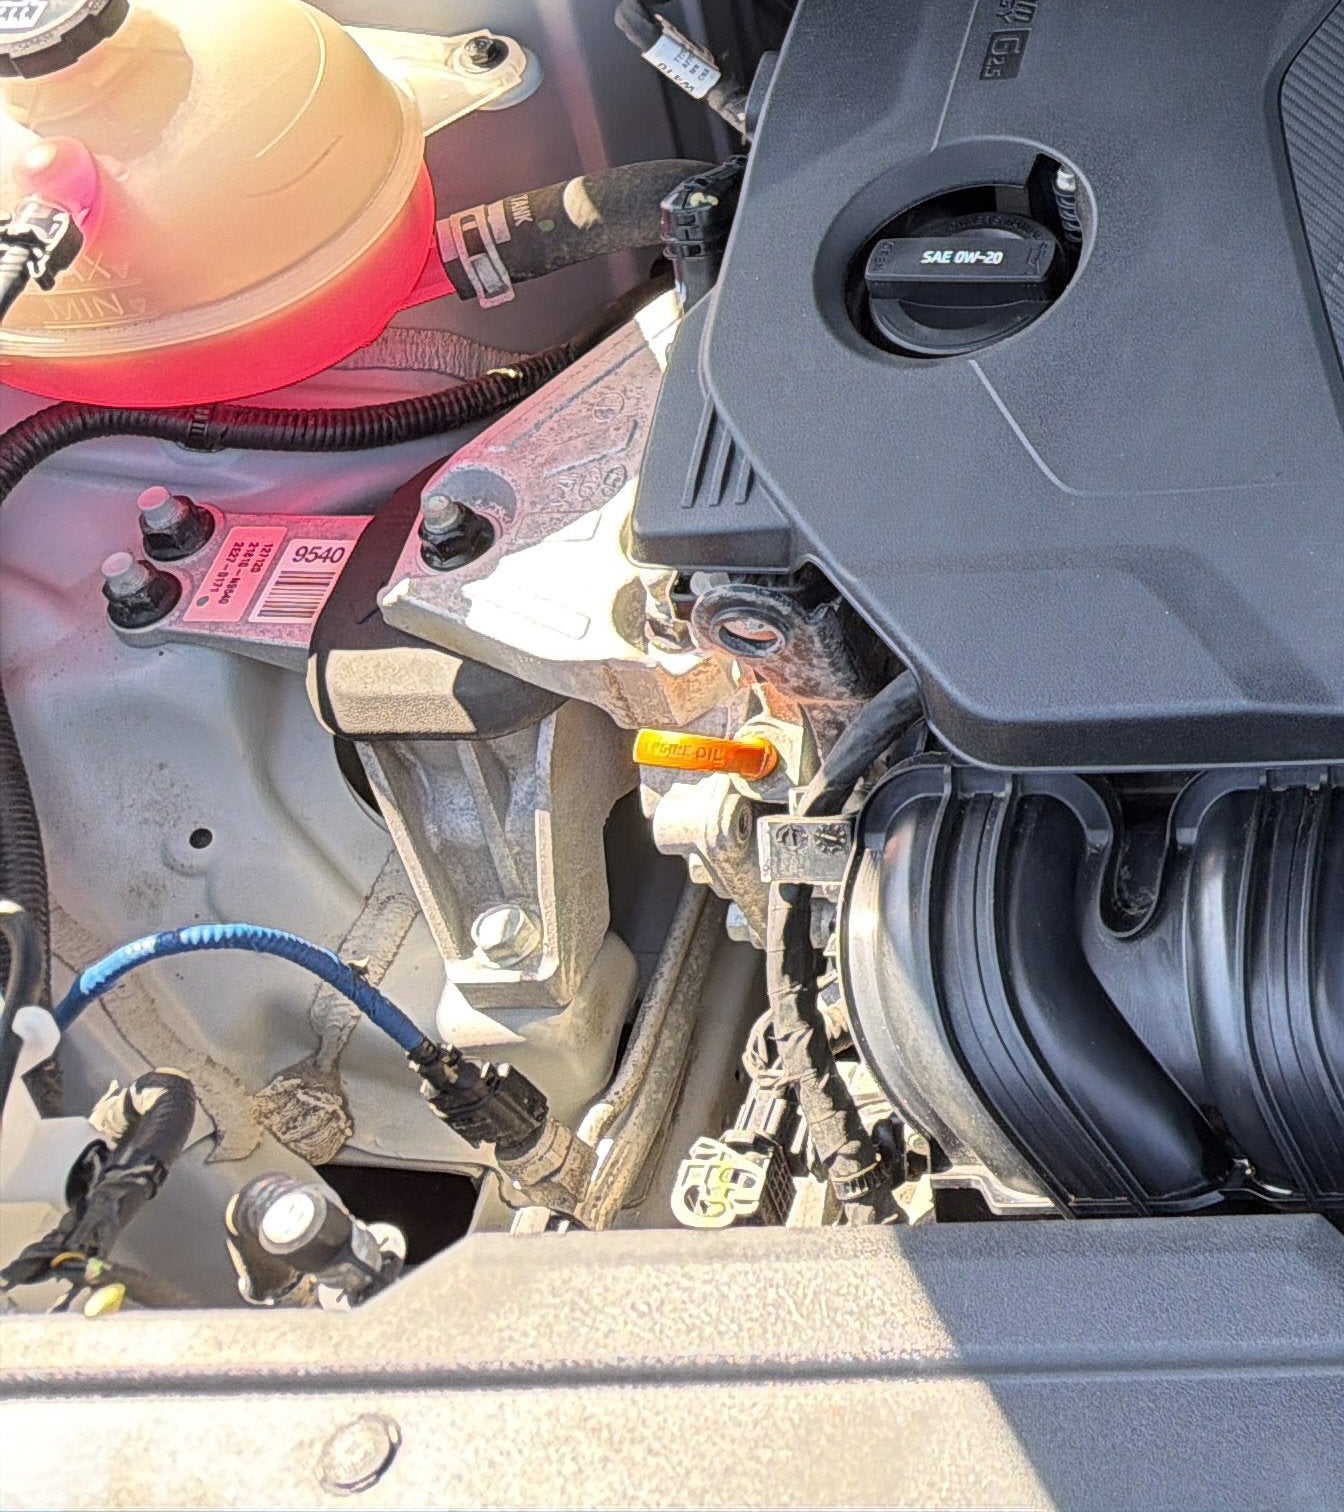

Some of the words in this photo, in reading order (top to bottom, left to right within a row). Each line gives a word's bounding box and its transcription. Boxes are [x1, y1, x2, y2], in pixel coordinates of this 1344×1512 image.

[511, 193, 534, 228] TANK
[920, 250, 954, 264] SAE
[954, 250, 1004, 265] 0W-20
[45, 292, 125, 321] MIN
[292, 545, 346, 564] 9540
[694, 746, 723, 763] OIL
